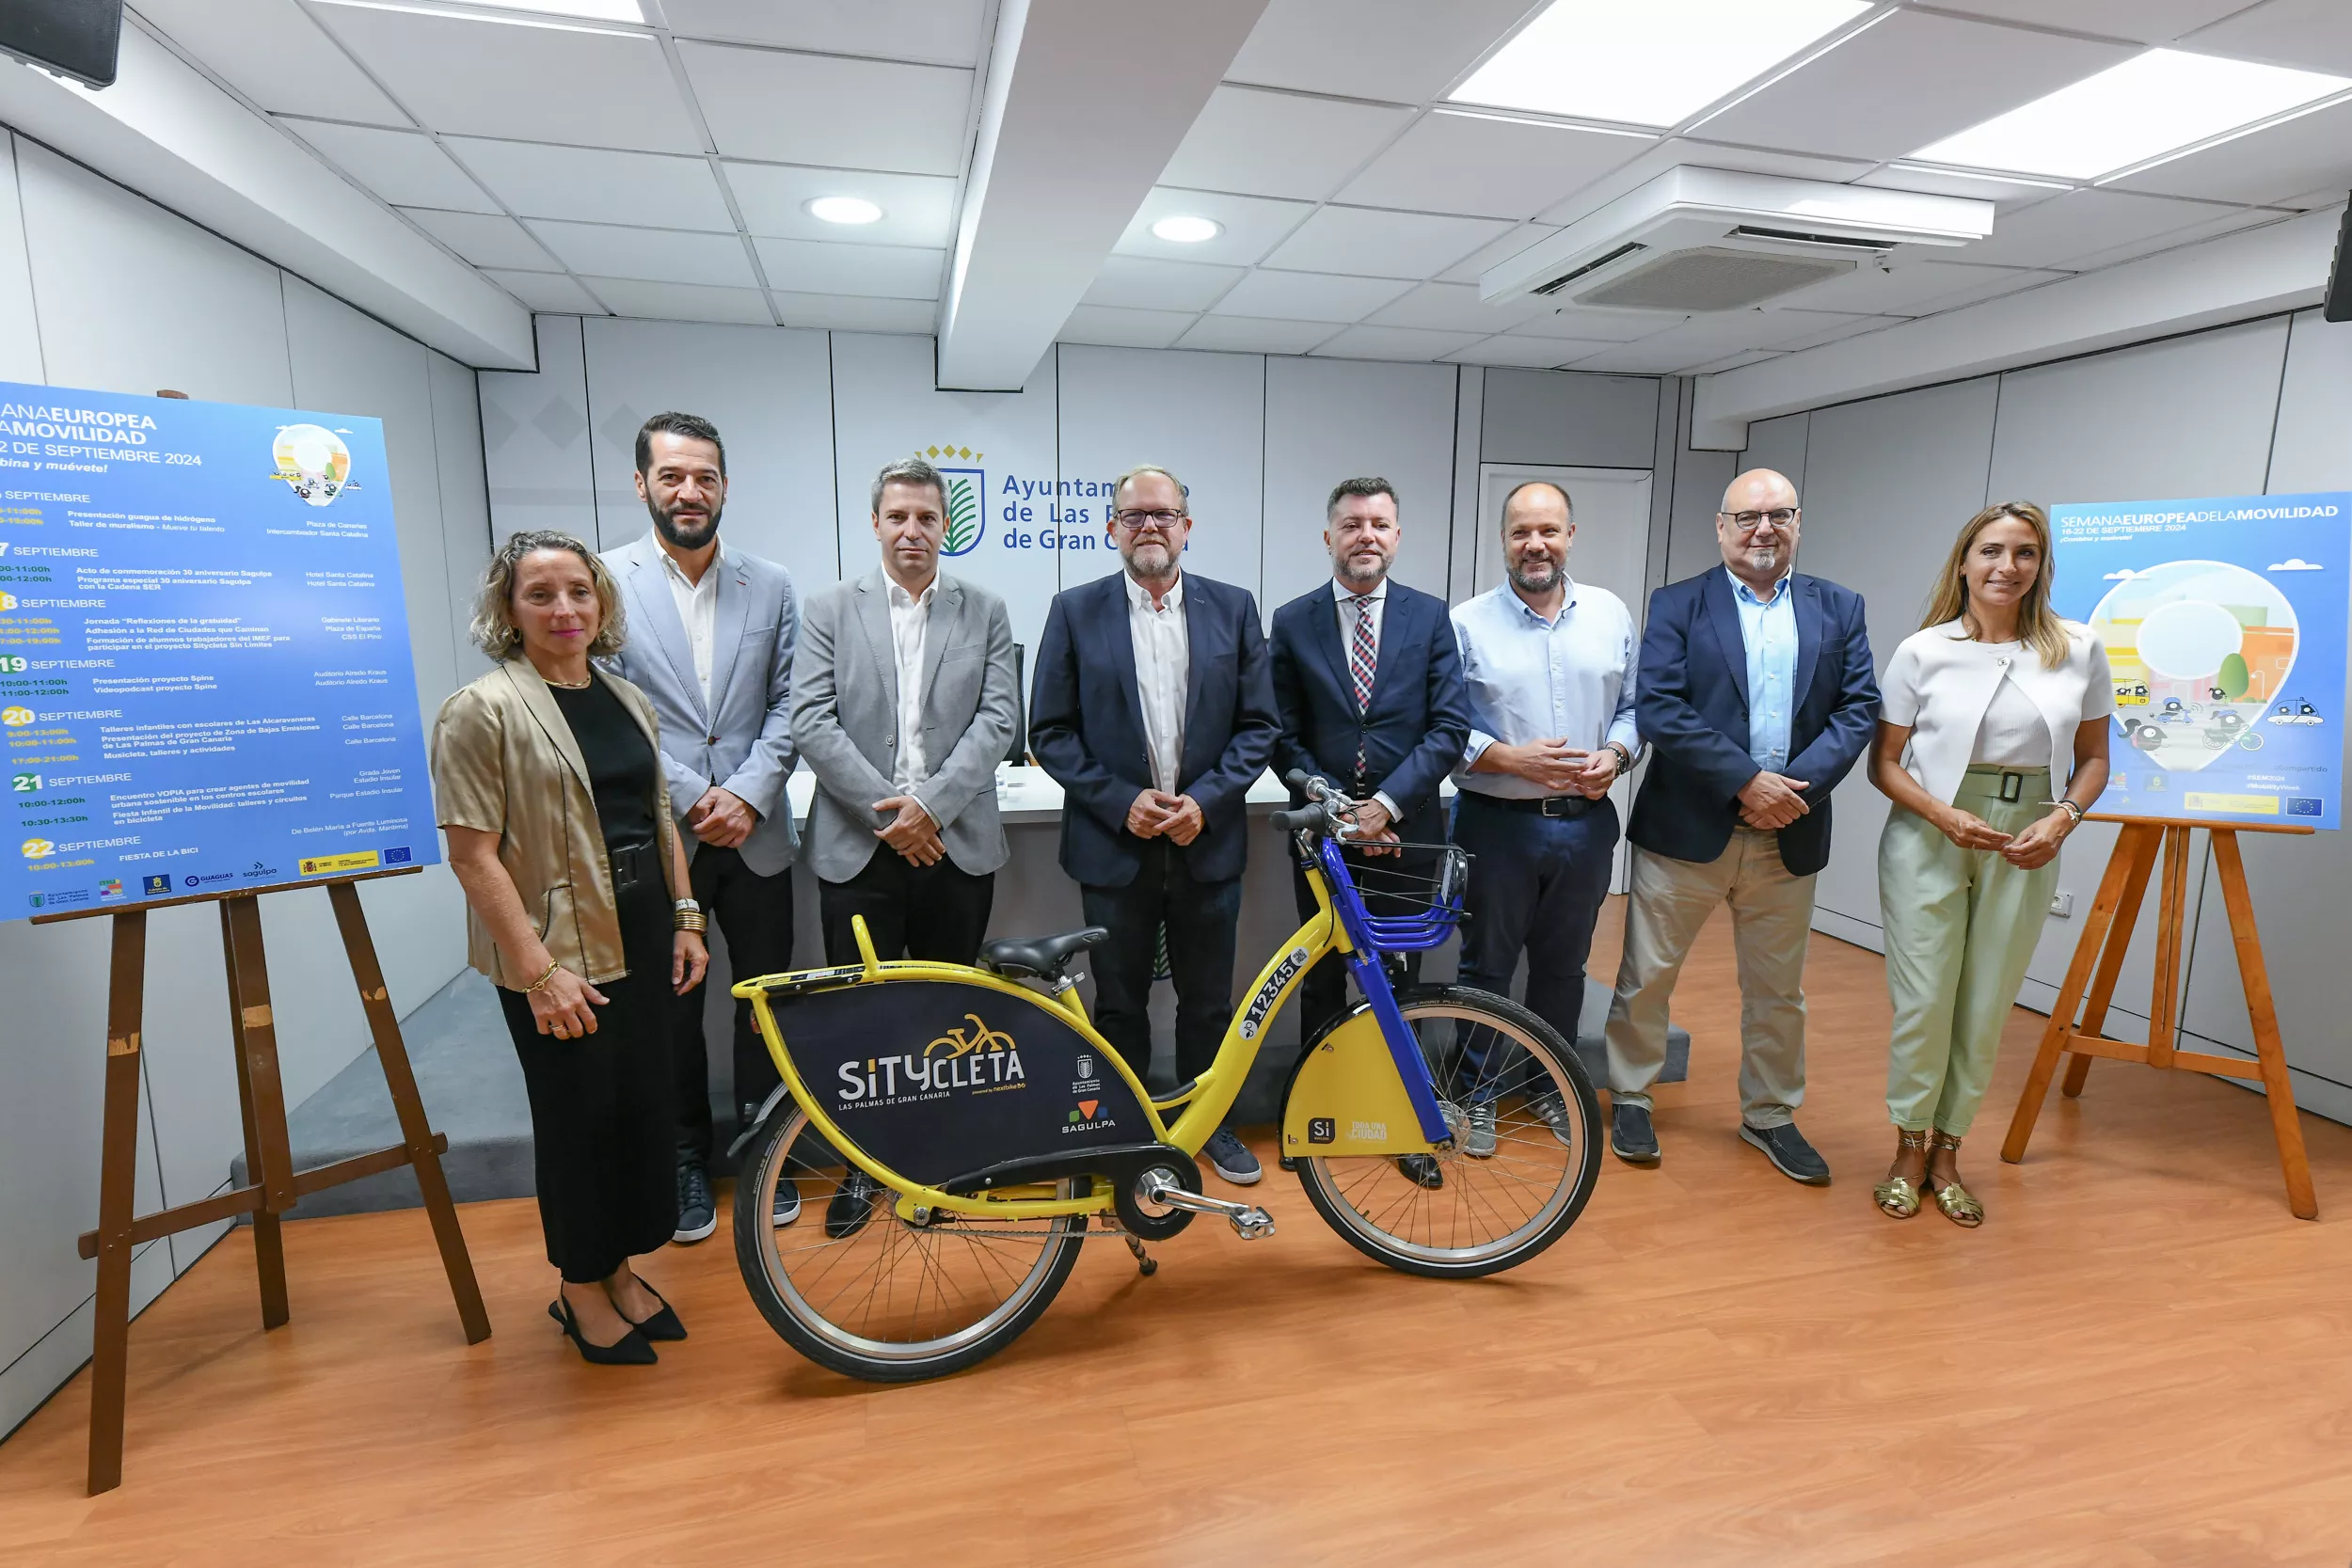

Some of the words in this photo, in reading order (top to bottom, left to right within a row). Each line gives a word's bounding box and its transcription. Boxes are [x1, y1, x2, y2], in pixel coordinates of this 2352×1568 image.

[0, 403, 157, 430] ANAEUROPEA
[0, 421, 147, 445] AMOVILIDAD
[0, 440, 8, 453] 2
[13, 442, 40, 454] DE
[45, 444, 161, 463] SEPTIEMBRE
[165, 452, 202, 466] 2024
[0, 457, 29, 468] bina
[46, 462, 108, 473] muévete!
[1002, 474, 1190, 500] Ayuntam
[5, 490, 91, 503] SEPTIEMBRE
[68, 510, 125, 519] Presentación
[128, 514, 159, 523] guagua
[174, 515, 215, 523] hidrógeno
[1003, 500, 1033, 522] de
[1050, 503, 1089, 523] Las
[2102, 525, 2162, 534] SEPTIEMBRE
[1003, 528, 1032, 549] de
[1039, 529, 1095, 550] Gran
[13, 546, 99, 558] SEPTIEMBRE
[77, 576, 120, 584] Programa
[240, 570, 273, 578] Sagulpa
[22, 599, 106, 608] SEPTIEMBRE
[31, 659, 115, 670] SEPTIEMBRE
[4, 709, 35, 725] 20
[39, 710, 123, 721] SEPTIEMBRE
[102, 733, 158, 742] Presentación
[175, 730, 211, 739] proyecto
[190, 744, 236, 753] actividades
[13, 775, 42, 791] 21
[48, 773, 132, 787] SEPTIEMBRE
[110, 792, 155, 800] Encuentro
[229, 783, 260, 792] agentes
[144, 796, 187, 805] sostenible
[248, 788, 285, 797] escolares
[18, 797, 85, 808] 10:00-12:00h
[195, 802, 236, 811] Movilidad:
[21, 816, 88, 827] 10:30-13:30h
[127, 815, 163, 824] bicicleta
[23, 840, 56, 858] 22
[58, 836, 142, 853] SEPTIEMBRE
[119, 852, 151, 861] FIESTA
[243, 868, 277, 877] sagulpa
[1251, 962, 1294, 1022] 12345
[855, 1099, 884, 1109] PALMAS
[898, 1095, 917, 1104] GRAN
[920, 1091, 950, 1101] CANARIA
[1062, 1120, 1115, 1133] SAGULPA
[1351, 1129, 1387, 1140] CIUDAD
